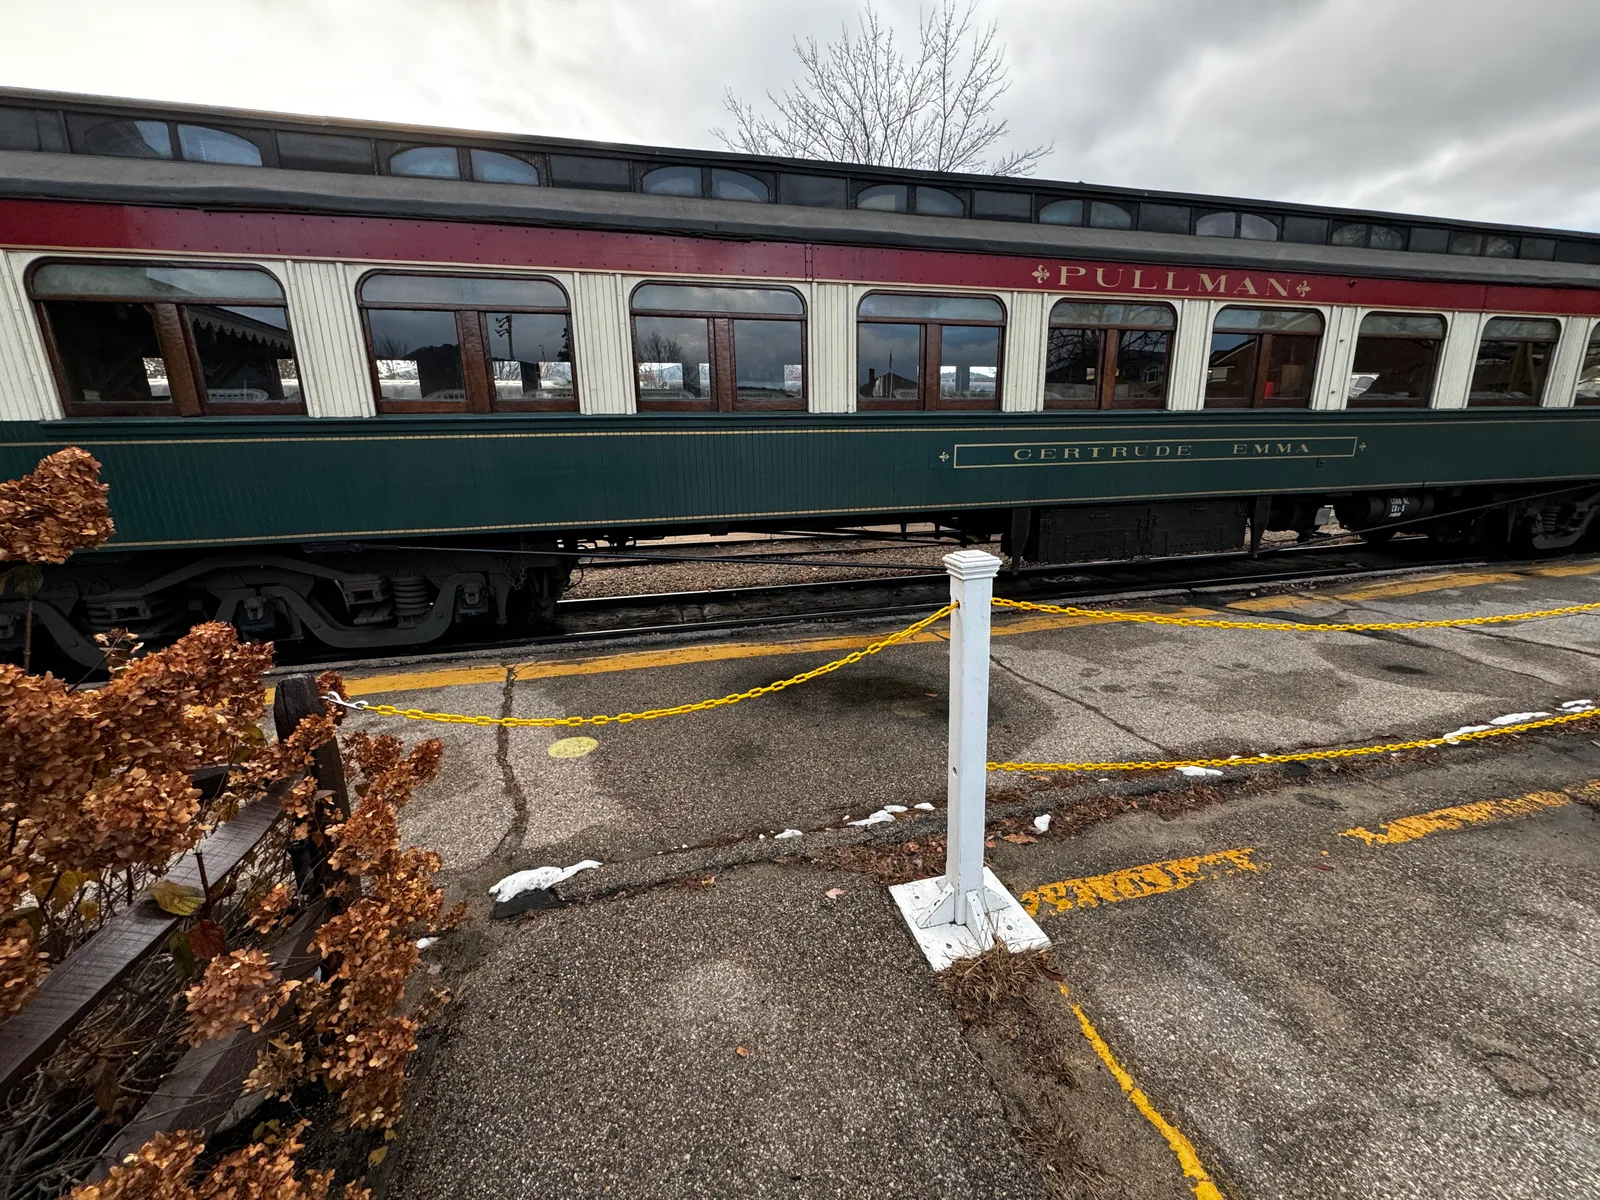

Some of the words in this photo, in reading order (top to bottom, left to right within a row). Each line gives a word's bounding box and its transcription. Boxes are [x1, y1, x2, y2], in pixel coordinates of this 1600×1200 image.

[1058, 265, 1291, 297] PULLMAN
[1013, 445, 1193, 461] GERTRUDE
[1232, 443, 1311, 456] EMMA
